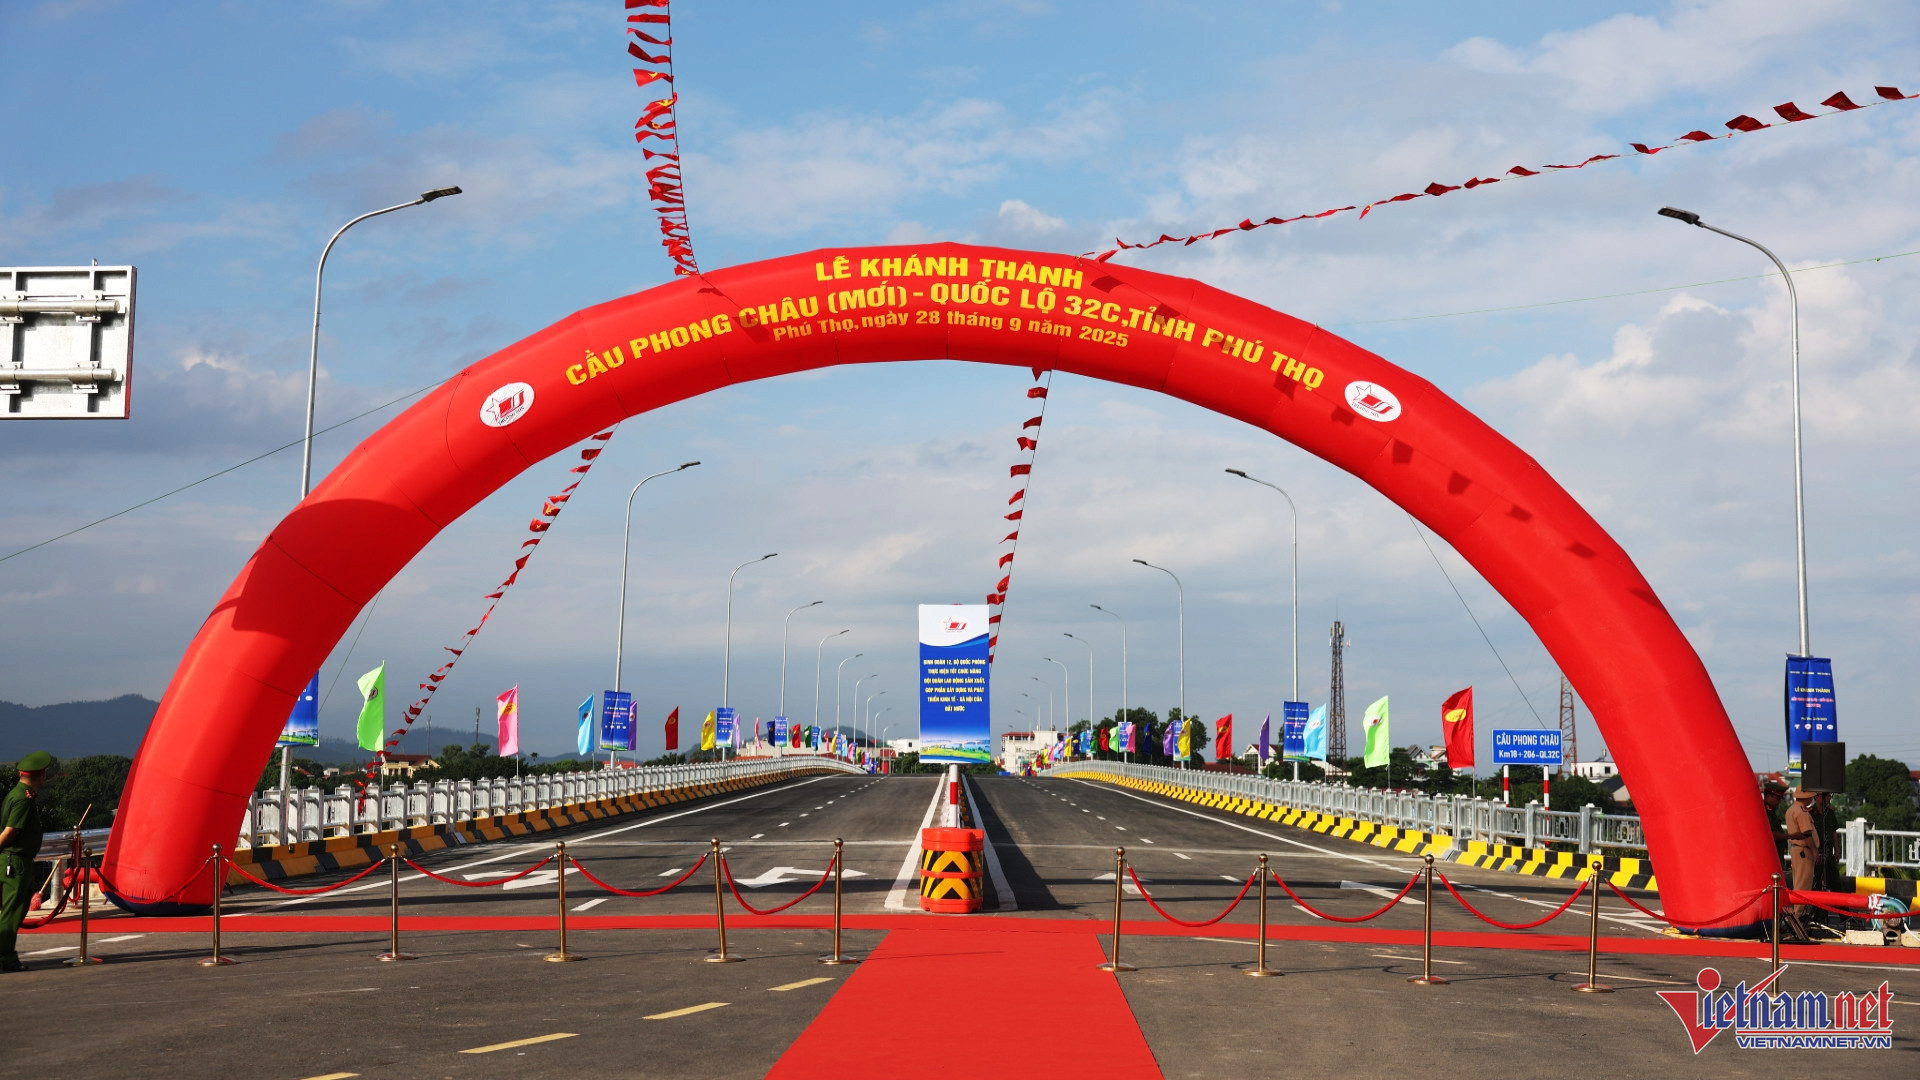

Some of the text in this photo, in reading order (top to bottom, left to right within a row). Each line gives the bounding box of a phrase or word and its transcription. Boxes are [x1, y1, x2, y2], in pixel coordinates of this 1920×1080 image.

[816, 253, 1084, 290] LỄ KHÁNH THÀNH
[565, 349, 625, 386] CẦU
[629, 313, 733, 359] PHONG
[738, 296, 820, 328] CHÂU
[827, 279, 908, 314] (MỚI)
[930, 279, 1011, 307] QUỐC
[1020, 287, 1057, 315] LỘ
[1201, 327, 1265, 364] PHÚ
[1269, 350, 1325, 392] THỌ
[773, 320, 812, 342] Phú
[861, 310, 909, 328] ngày
[915, 310, 941, 325] 28
[946, 310, 1004, 331] tháng
[1009, 317, 1022, 332] 9
[1028, 318, 1072, 338] năm
[1078, 325, 1129, 348] 2025
[1496, 732, 1560, 746] CẦU PHONG CHÂU
